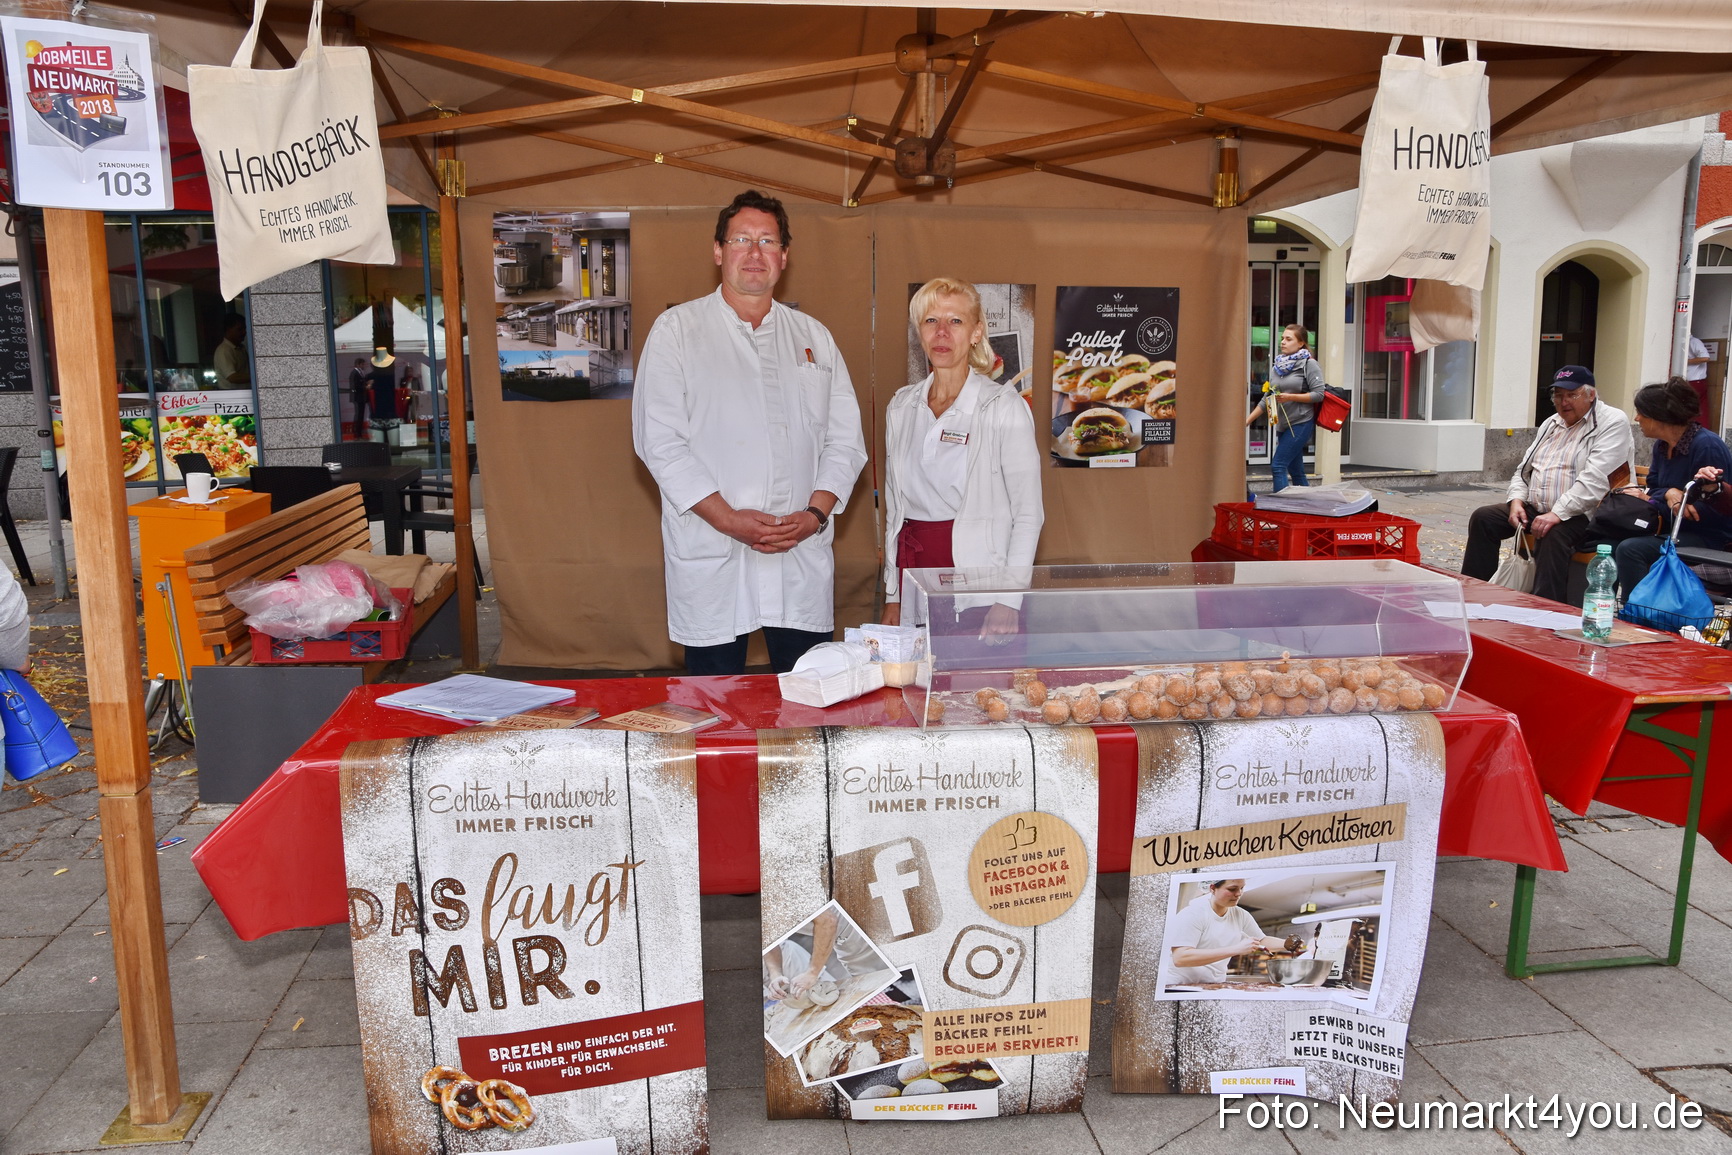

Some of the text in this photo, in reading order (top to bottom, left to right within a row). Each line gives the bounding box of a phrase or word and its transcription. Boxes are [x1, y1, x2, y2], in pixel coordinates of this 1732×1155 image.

[37, 50, 108, 67] JOBMEILE
[33, 69, 115, 95] NEUMARKT
[80, 99, 112, 115] 2018
[98, 171, 152, 196] 103
[1066, 330, 1126, 348] Pulled
[1065, 345, 1123, 367] Pork
[214, 402, 249, 414] Pizza
[842, 759, 1024, 795] Echtes Handwerk
[1215, 755, 1378, 790] Echtes Handwerk
[427, 776, 618, 814] Echtes Handwerk
[868, 795, 1000, 813] IMMER FRISCH
[1236, 788, 1355, 806] IMMER FRISCH
[455, 814, 594, 833] IMMER FRISCH
[1143, 812, 1396, 867] Wir suchen Konditoren
[984, 847, 1066, 868] FOLGT UNS AUF
[983, 860, 1070, 883] FACEBOOK &
[989, 875, 1067, 897] INSTAGRAM
[347, 852, 646, 946] DAS laugt
[1013, 896, 1046, 907] BÄCKER
[1049, 891, 1074, 901] FEIHL
[408, 934, 601, 1018] MIR.
[933, 1008, 1048, 1027] ALLE INFOS ZUM
[1309, 1015, 1386, 1038] BEWIRB DICH
[488, 1022, 677, 1062] BREZEN SIND EINFACH DER HIT.
[934, 1028, 989, 1041] BÄCKER
[994, 1024, 1033, 1037] FEIHL
[502, 1038, 668, 1074] FÜR KINDER. FÜR ERWACHSENE.
[934, 1035, 1080, 1057] BEQUEM SERVIERT!
[1289, 1031, 1404, 1060] JETZT FÜR UNSERE
[560, 1061, 614, 1078] FÜR DICH.
[1294, 1046, 1401, 1076] NEUE BACKSTUBE!
[1239, 1076, 1272, 1085] BÄCKER
[899, 1103, 945, 1112] BÄCKER
